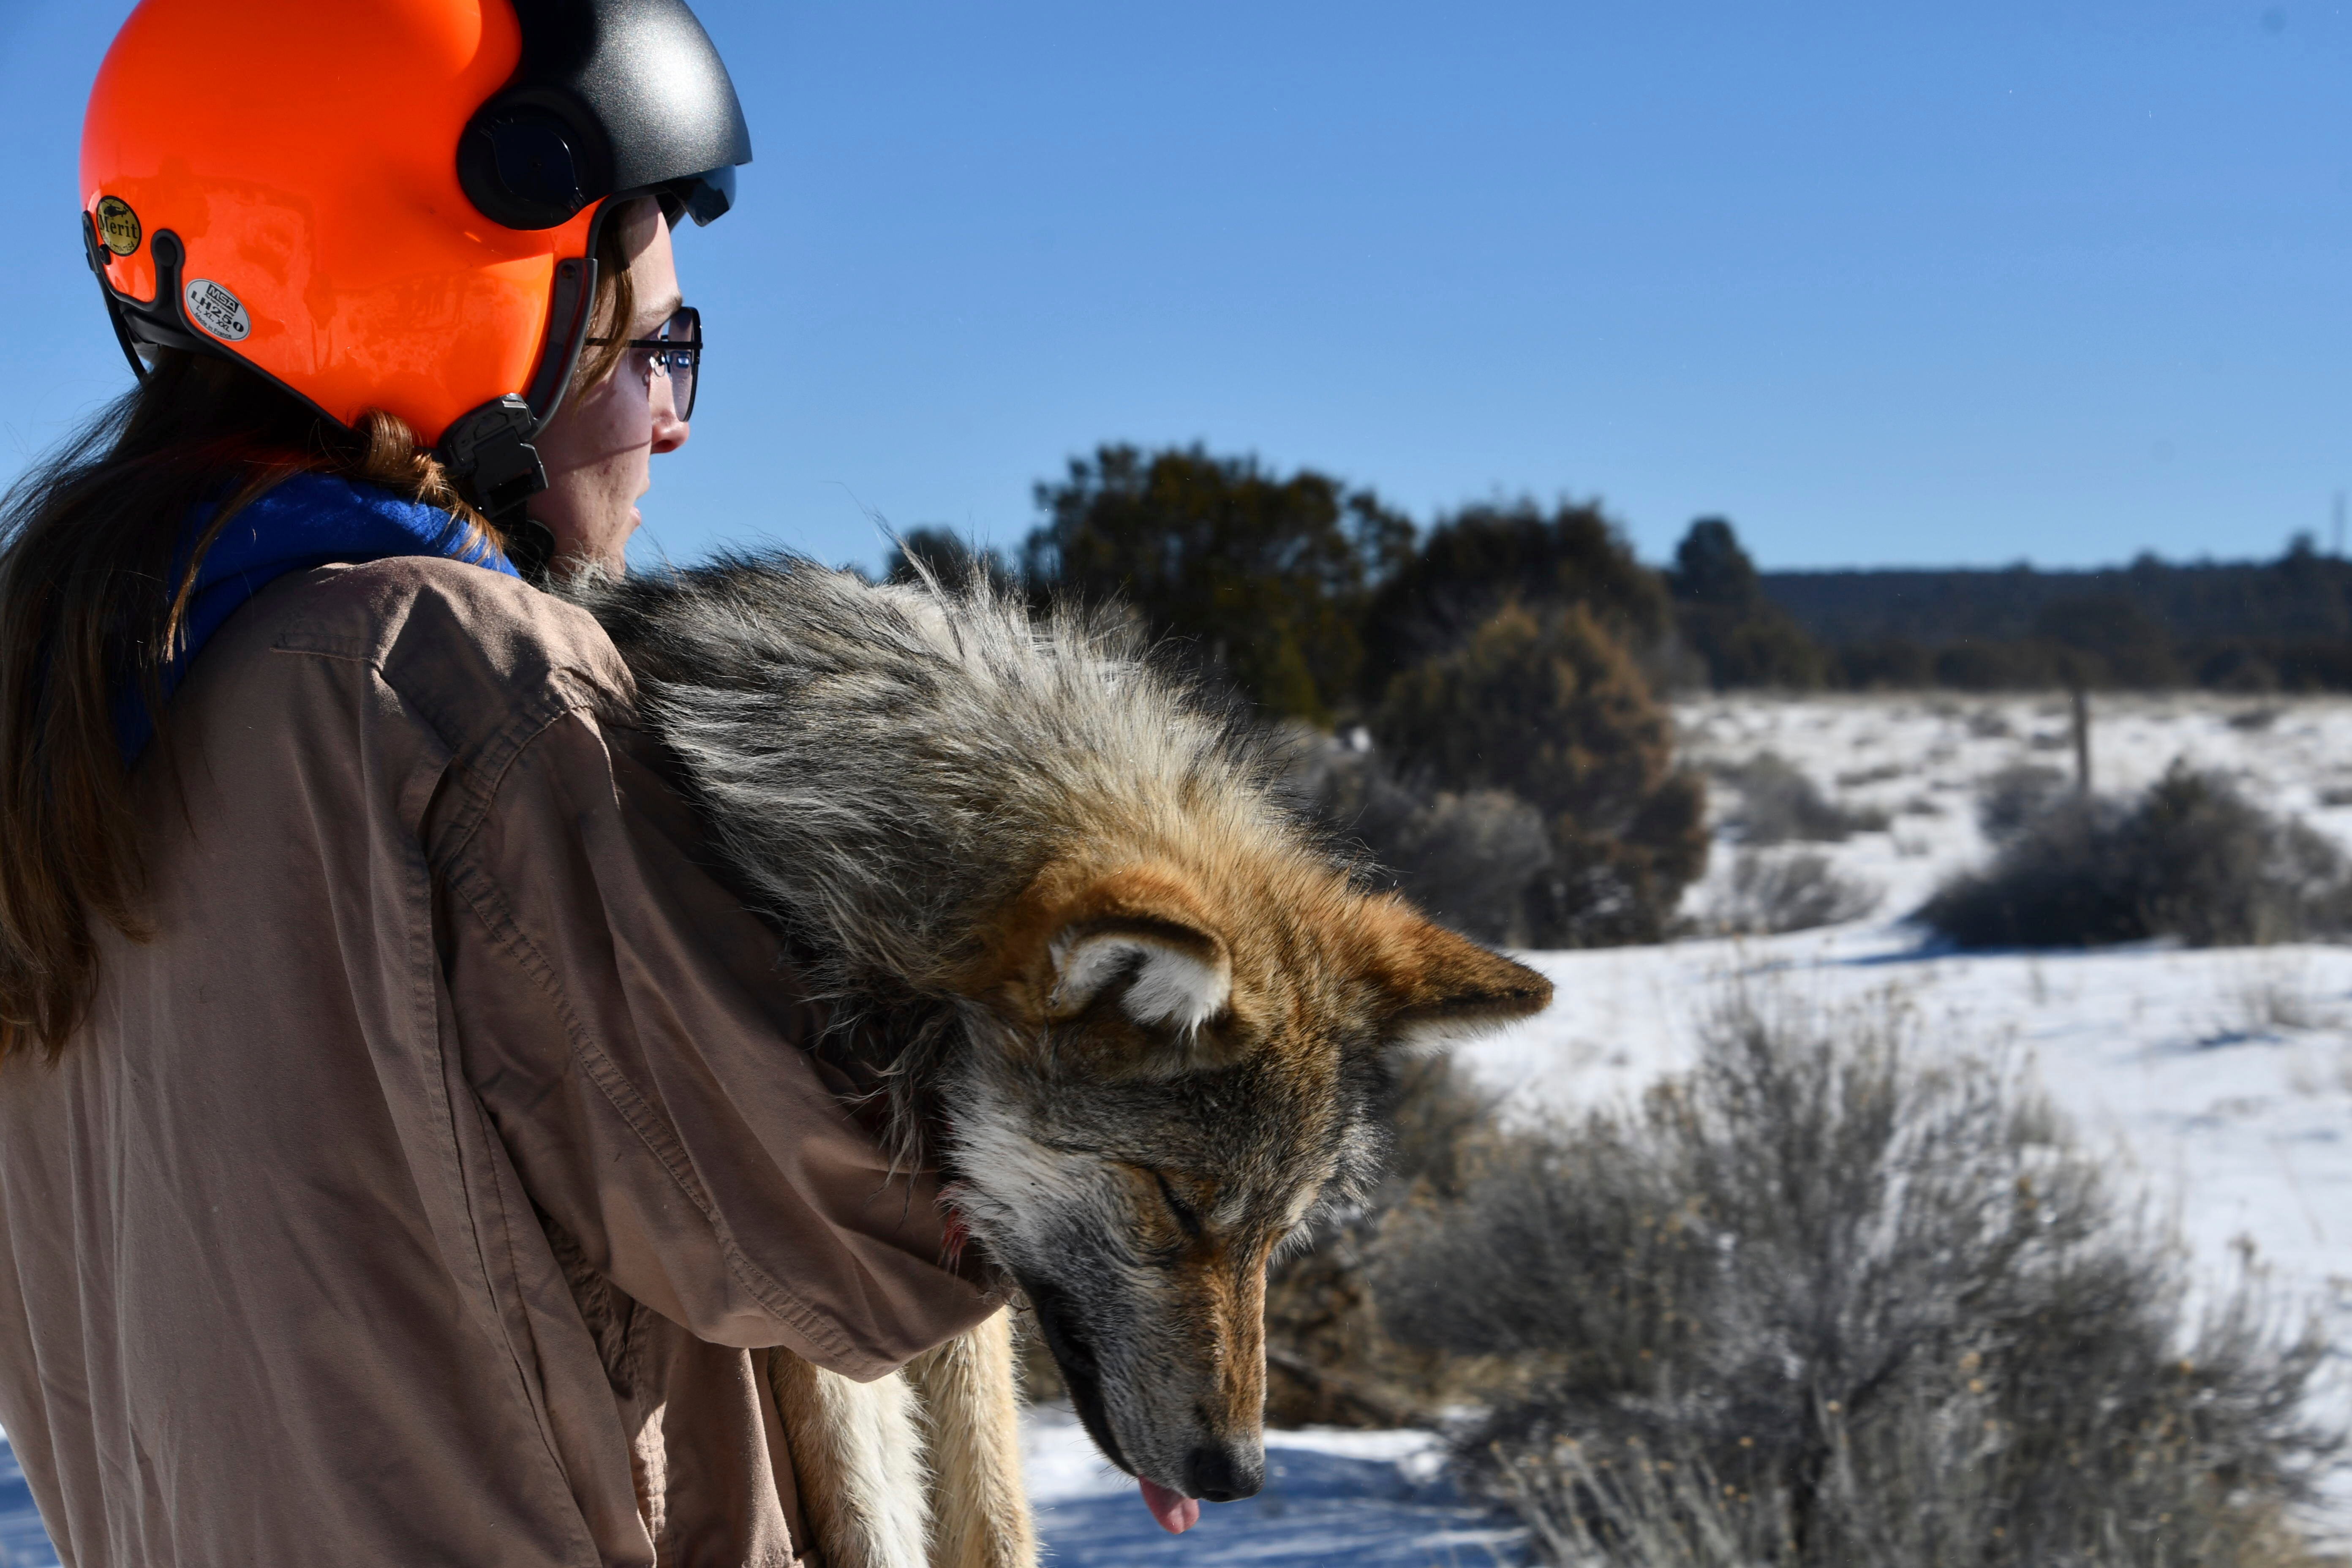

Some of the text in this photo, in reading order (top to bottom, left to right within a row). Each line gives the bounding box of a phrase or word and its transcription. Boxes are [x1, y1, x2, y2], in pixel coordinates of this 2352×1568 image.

[98, 214, 138, 239] Merit
[208, 287, 235, 311] MSA
[210, 297, 219, 306] Safety
[219, 304, 234, 316] Company
[191, 291, 244, 332] LH250
[204, 311, 214, 322] XL,
[216, 319, 229, 332] XXL
[195, 313, 207, 327] Made
[214, 328, 232, 338] France
